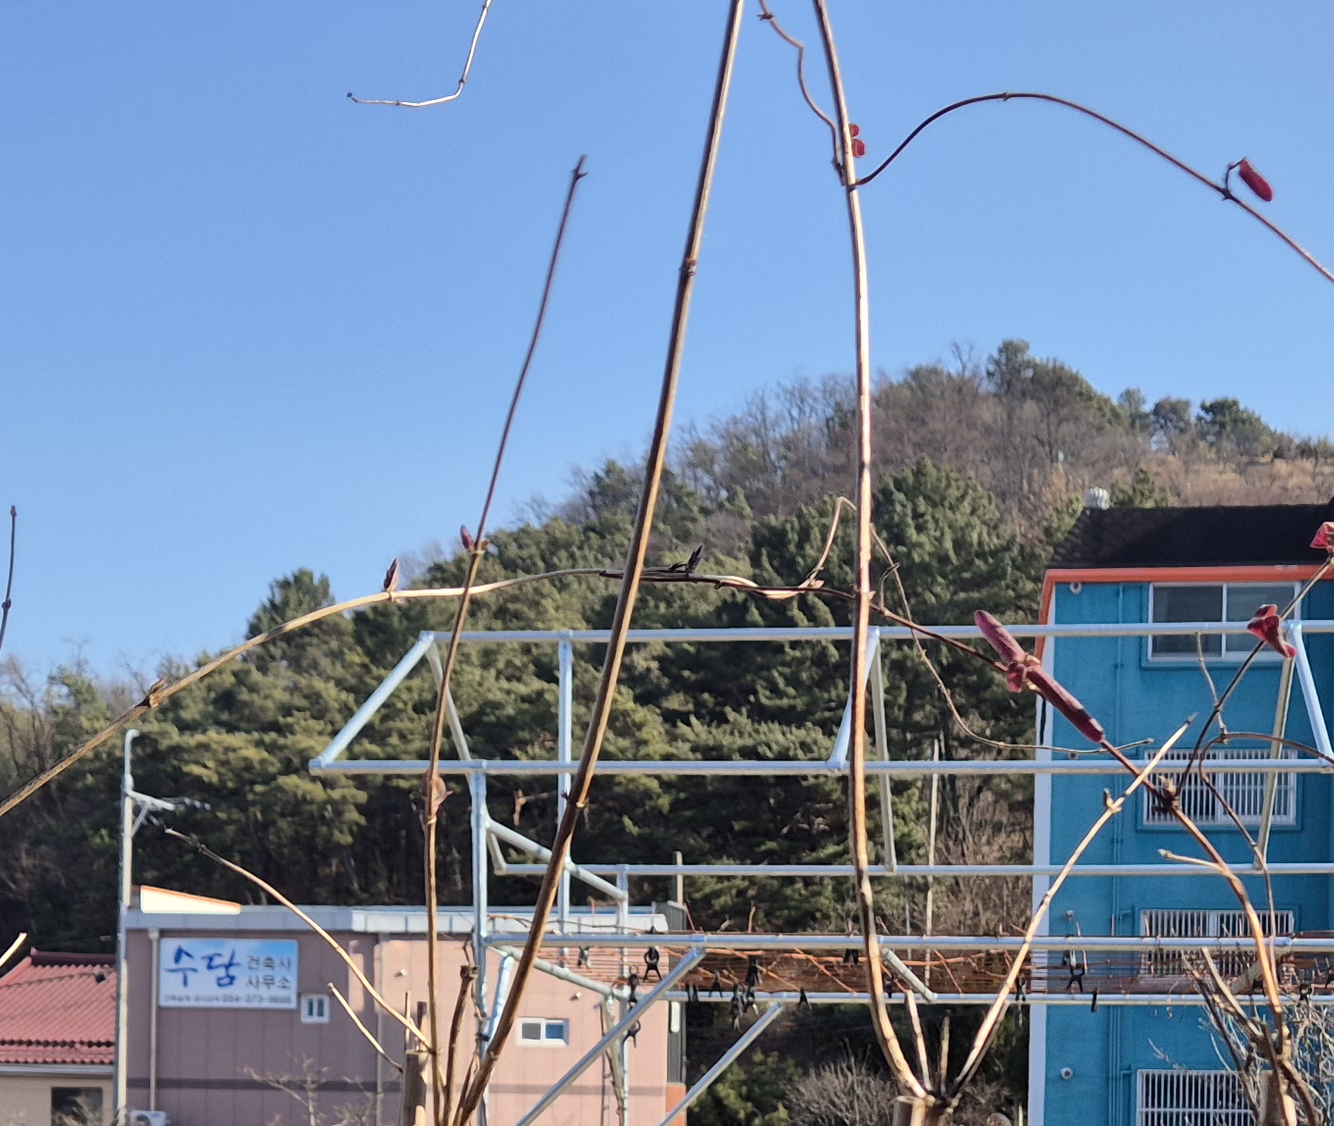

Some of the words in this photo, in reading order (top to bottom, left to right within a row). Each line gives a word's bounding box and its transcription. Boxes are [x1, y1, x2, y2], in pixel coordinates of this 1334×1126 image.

[164, 944, 242, 988] 수담
[246, 954, 292, 971] 건축사
[245, 973, 292, 990] 사무소
